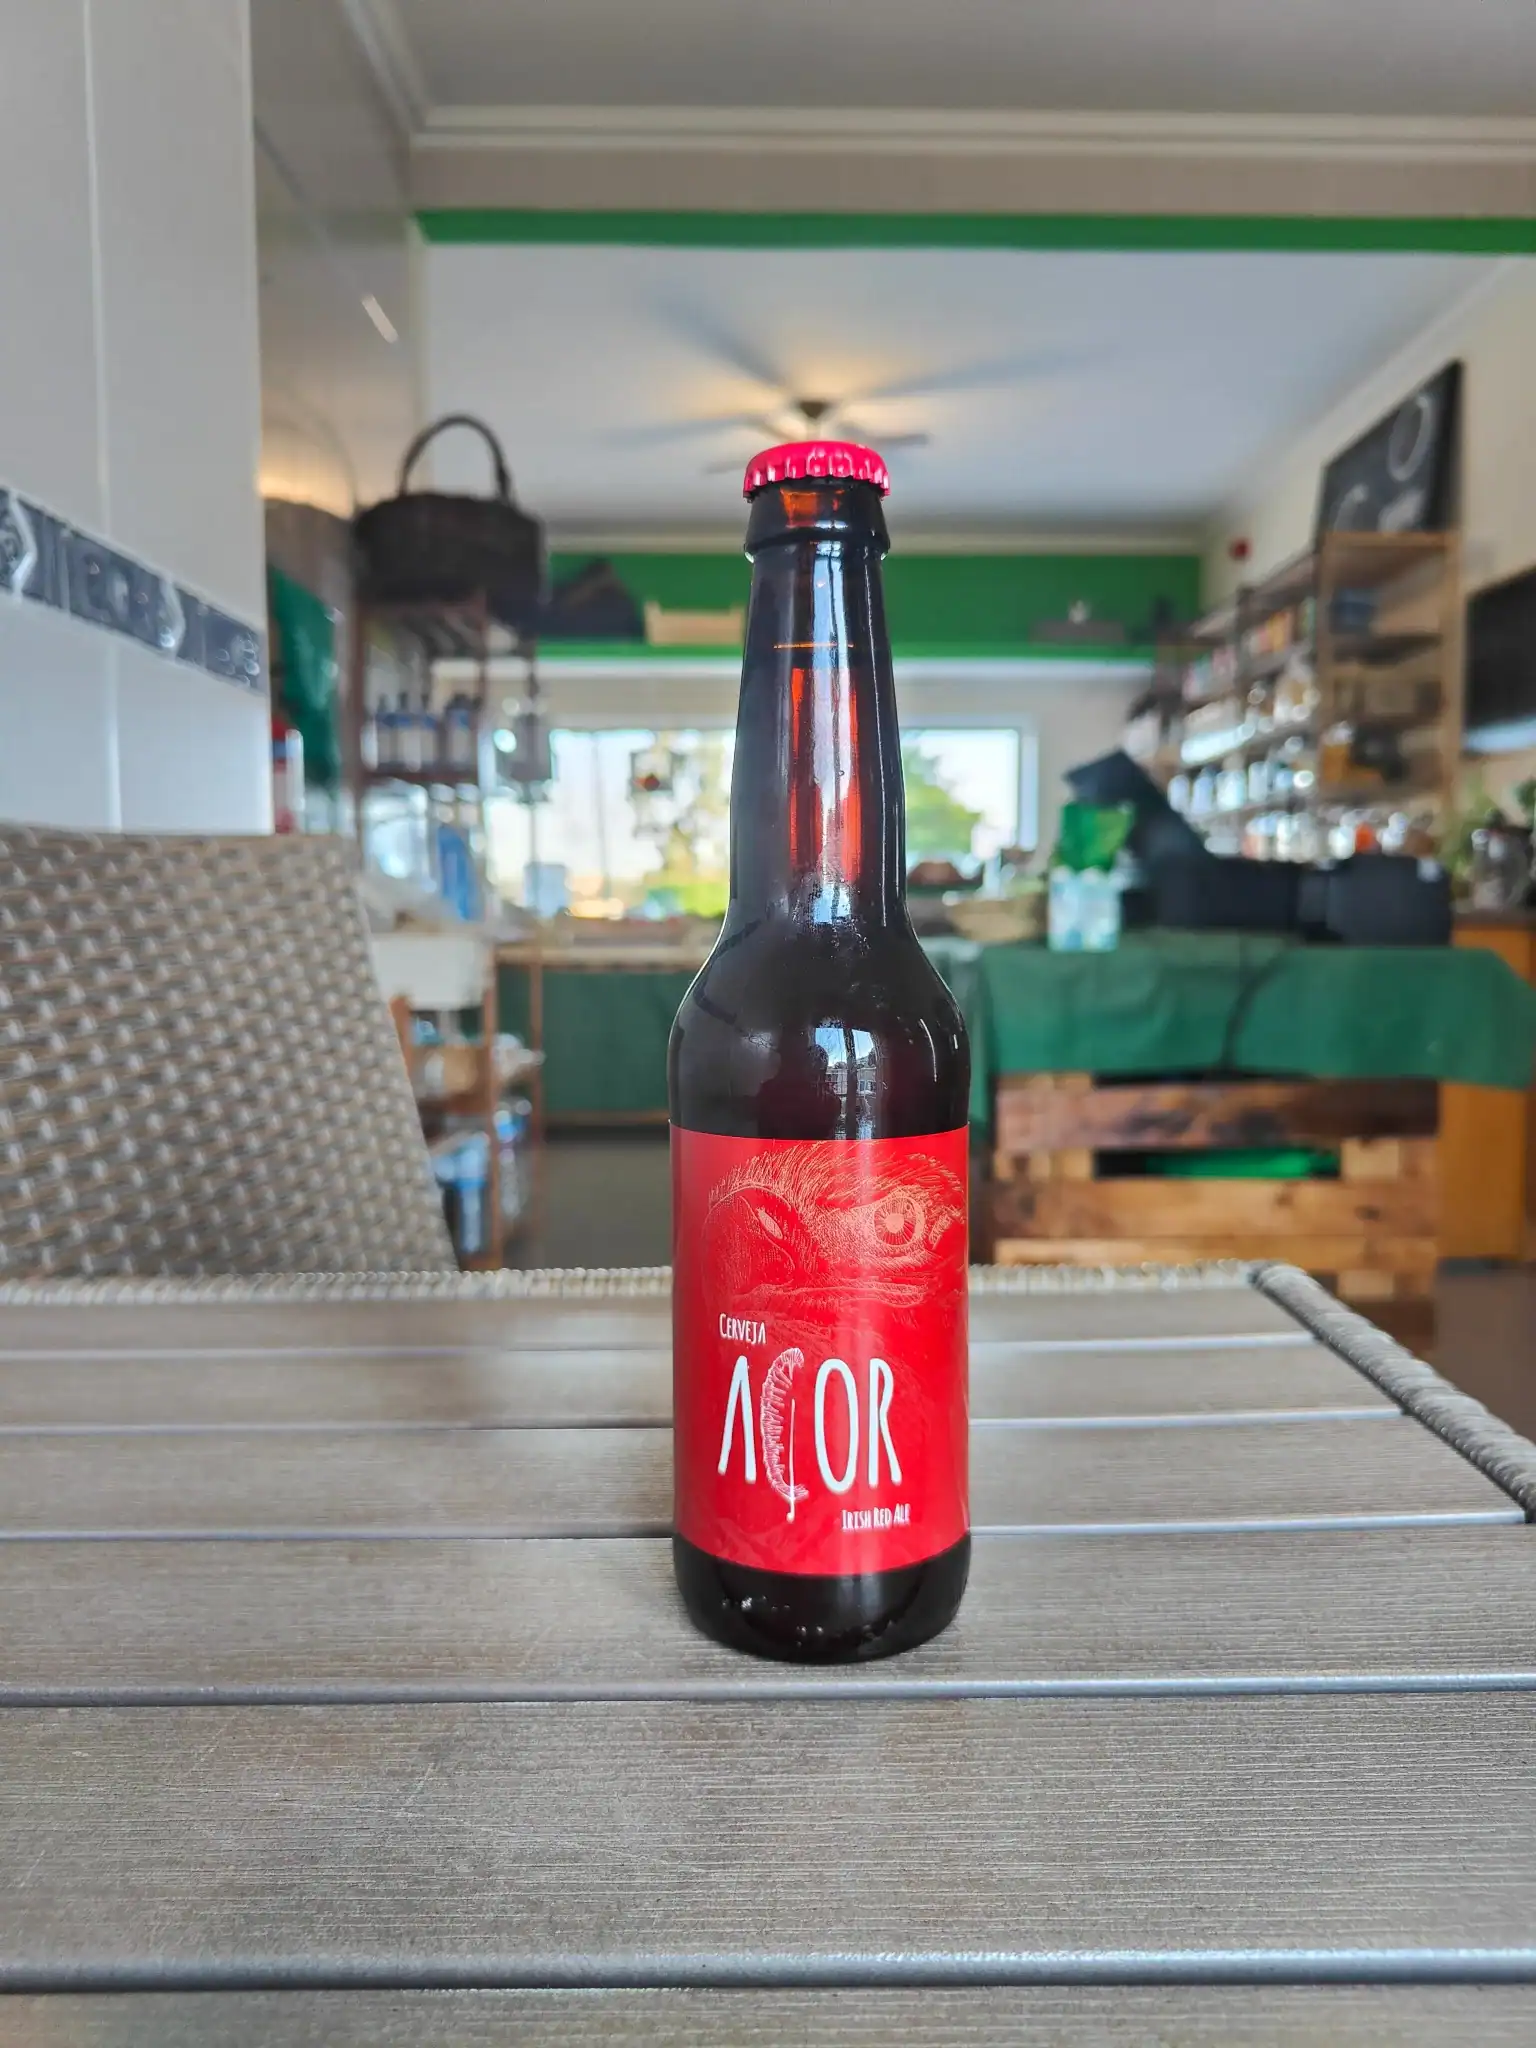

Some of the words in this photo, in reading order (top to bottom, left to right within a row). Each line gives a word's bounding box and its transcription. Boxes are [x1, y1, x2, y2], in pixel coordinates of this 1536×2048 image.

[719, 1313, 767, 1345] CERVEJA
[841, 1509, 873, 1531] IRISH
[873, 1506, 892, 1529] RED
[893, 1502, 911, 1526] ALE
